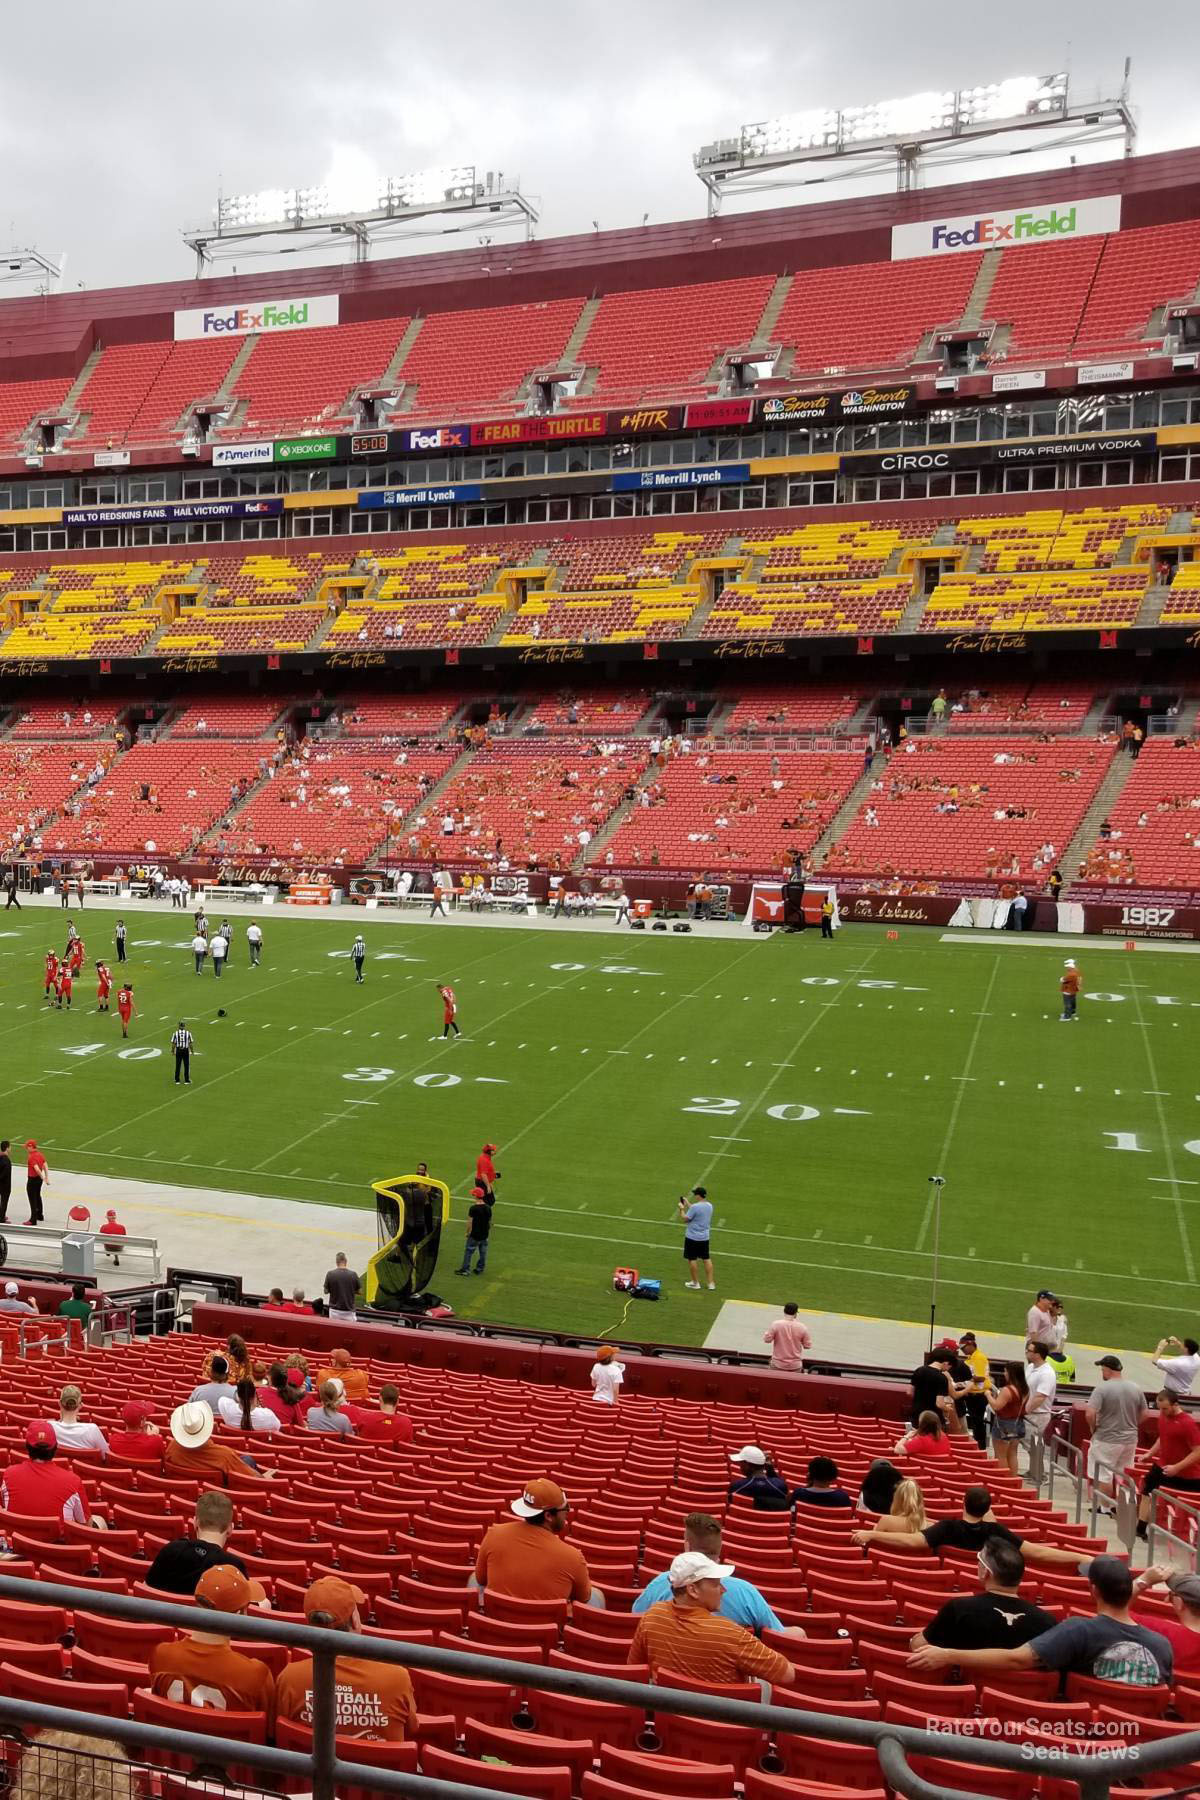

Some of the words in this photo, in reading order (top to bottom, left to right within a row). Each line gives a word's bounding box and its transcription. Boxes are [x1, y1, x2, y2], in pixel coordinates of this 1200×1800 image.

[932, 208, 1076, 249] FedExField
[204, 303, 308, 333] FedExField
[784, 396, 829, 412] Sports
[863, 389, 909, 405] Sports
[765, 409, 825, 421] WASHINGTON
[843, 402, 905, 415] WASHINGTON
[620, 409, 669, 431] #HTTR
[410, 428, 462, 449] FedEx
[225, 447, 270, 461] Ameritel
[290, 445, 310, 455] XBOX
[311, 443, 331, 453] ONE
[998, 448, 1035, 459] ULTRA
[1038, 443, 1095, 455] PREMIUM
[1098, 439, 1142, 450] VODKA
[881, 454, 949, 470] CÎROC
[655, 472, 689, 485] Merrill
[691, 471, 721, 483] Lynch
[396, 491, 426, 503] Merrill
[428, 490, 455, 502] Lynch
[173, 507, 192, 517] HAIL
[193, 505, 233, 516] VICTORY!
[245, 502, 269, 513] FedEx
[67, 513, 86, 523] HAIL
[86, 512, 98, 521] TO
[100, 510, 141, 521] REDSKINS
[143, 508, 167, 519] FANS.
[244, 867, 256, 881] to
[258, 868, 277, 882] the
[1121, 906, 1175, 926] 1987
[1102, 928, 1127, 936] SUPER
[1127, 929, 1149, 937] BOWL
[1149, 931, 1194, 939] CHAMPIONS
[59, 1042, 162, 1061] 40
[341, 1066, 462, 1088] 30
[681, 1096, 820, 1121] 20
[305, 1690, 382, 1705] FTBALL
